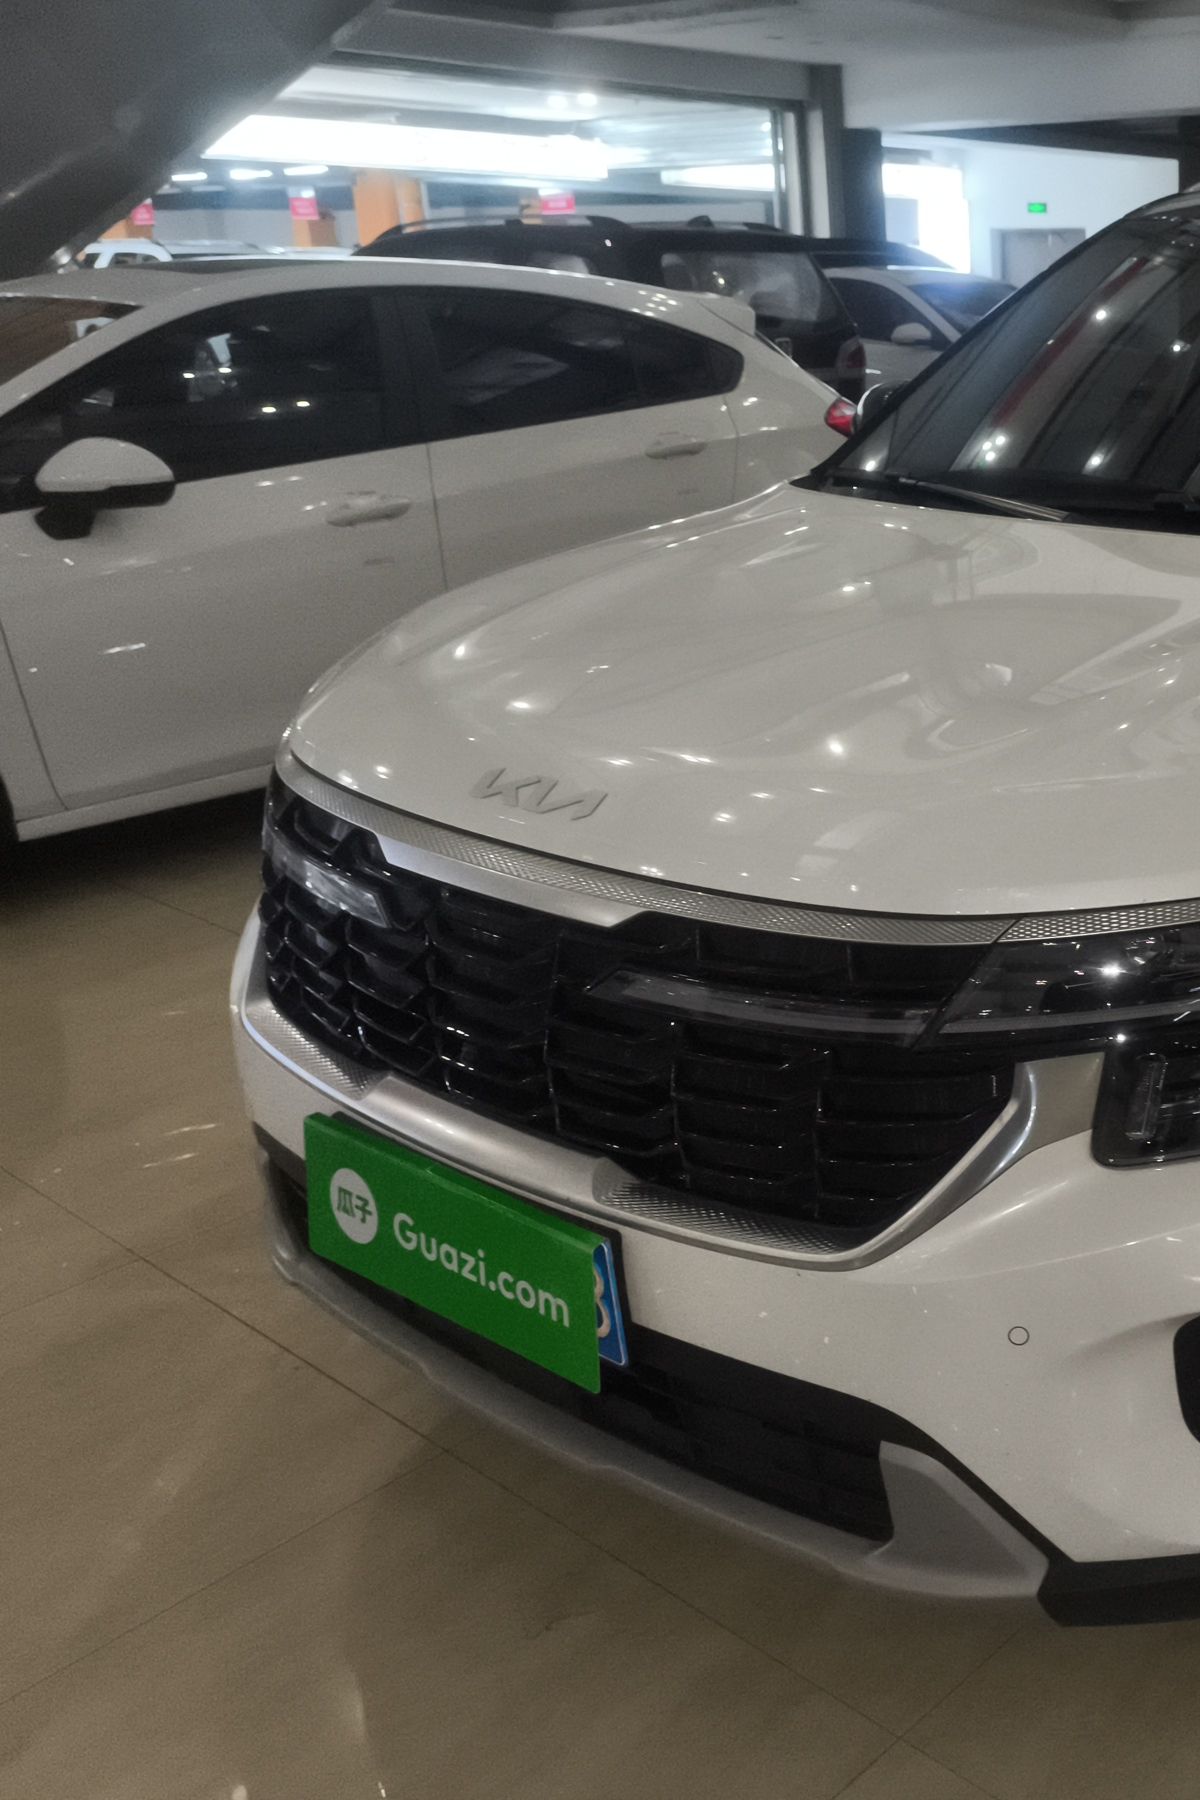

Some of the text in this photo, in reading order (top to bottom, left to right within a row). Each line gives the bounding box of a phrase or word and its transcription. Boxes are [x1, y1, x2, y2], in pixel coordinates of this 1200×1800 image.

[469, 767, 608, 821] KIA
[337, 1186, 373, 1224] 瓜子
[393, 1212, 570, 1328] Guazi.com
